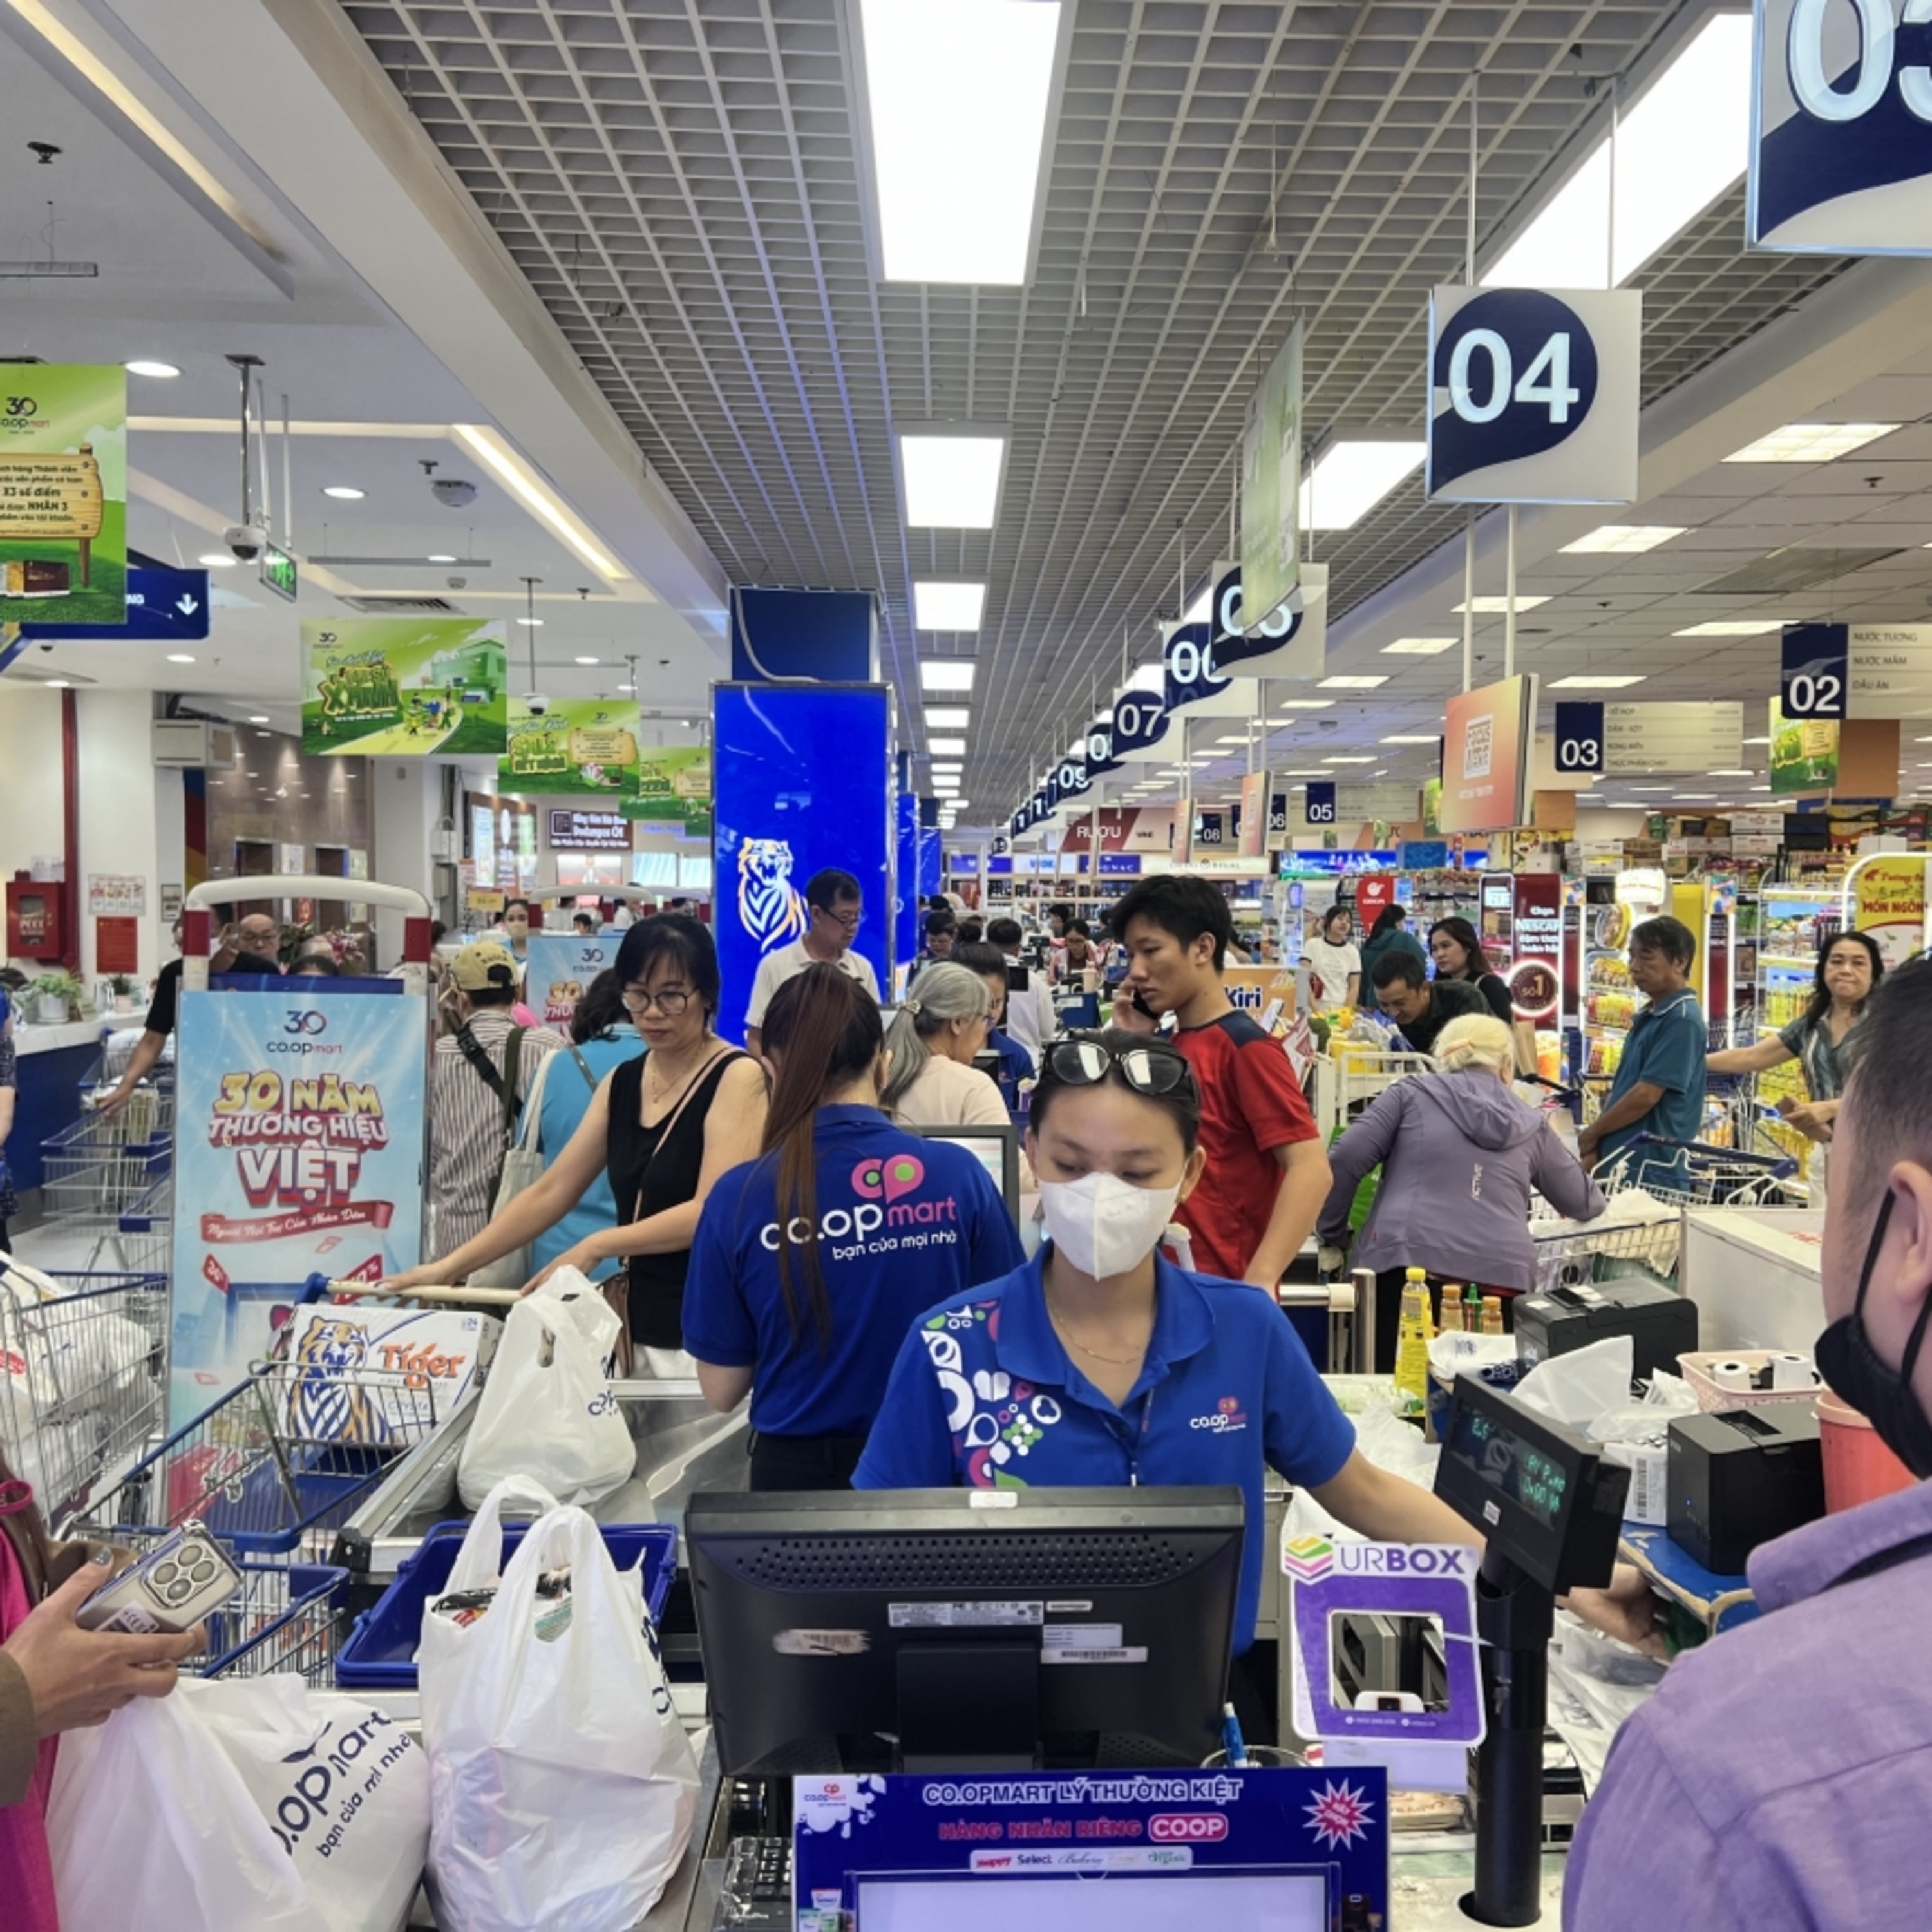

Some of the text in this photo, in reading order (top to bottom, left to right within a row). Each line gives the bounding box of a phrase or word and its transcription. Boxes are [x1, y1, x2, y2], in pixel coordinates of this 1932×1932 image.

[1788, 0, 1932, 123] 0
[1448, 328, 1580, 424] 04
[6, 397, 37, 416] 30
[34, 486, 61, 497] điểm
[1789, 675, 1841, 712] 02
[1118, 704, 1161, 737] 07
[1089, 733, 1113, 761] 0
[1561, 739, 1600, 768] 03
[1059, 766, 1090, 790] 09
[1309, 804, 1333, 822] 05
[1203, 828, 1221, 842] 08
[582, 948, 604, 962] 30
[1224, 987, 1261, 1008] Kiri
[1533, 974, 1544, 997] 1
[284, 1010, 327, 1035] 30
[213, 1070, 384, 1117] 30 NĂM
[209, 1113, 390, 1146] THƯƠNG HIỆU
[238, 1139, 361, 1201] VIỆT
[832, 1231, 958, 1260] bạn của mọi nhà
[377, 1341, 466, 1388] Tiger
[1340, 1547, 1466, 1575] URBOX
[923, 1775, 1243, 1805] CO.OPMART LÝ THƯỜNG KIỆT
[316, 1824, 345, 1858] bạn
[339, 1792, 364, 1824] của
[939, 1818, 1003, 1840] HÀNG
[1076, 1819, 1142, 1838] RIÊNG
[1151, 1815, 1225, 1838] COOP
[1017, 1854, 1052, 1866] Select
